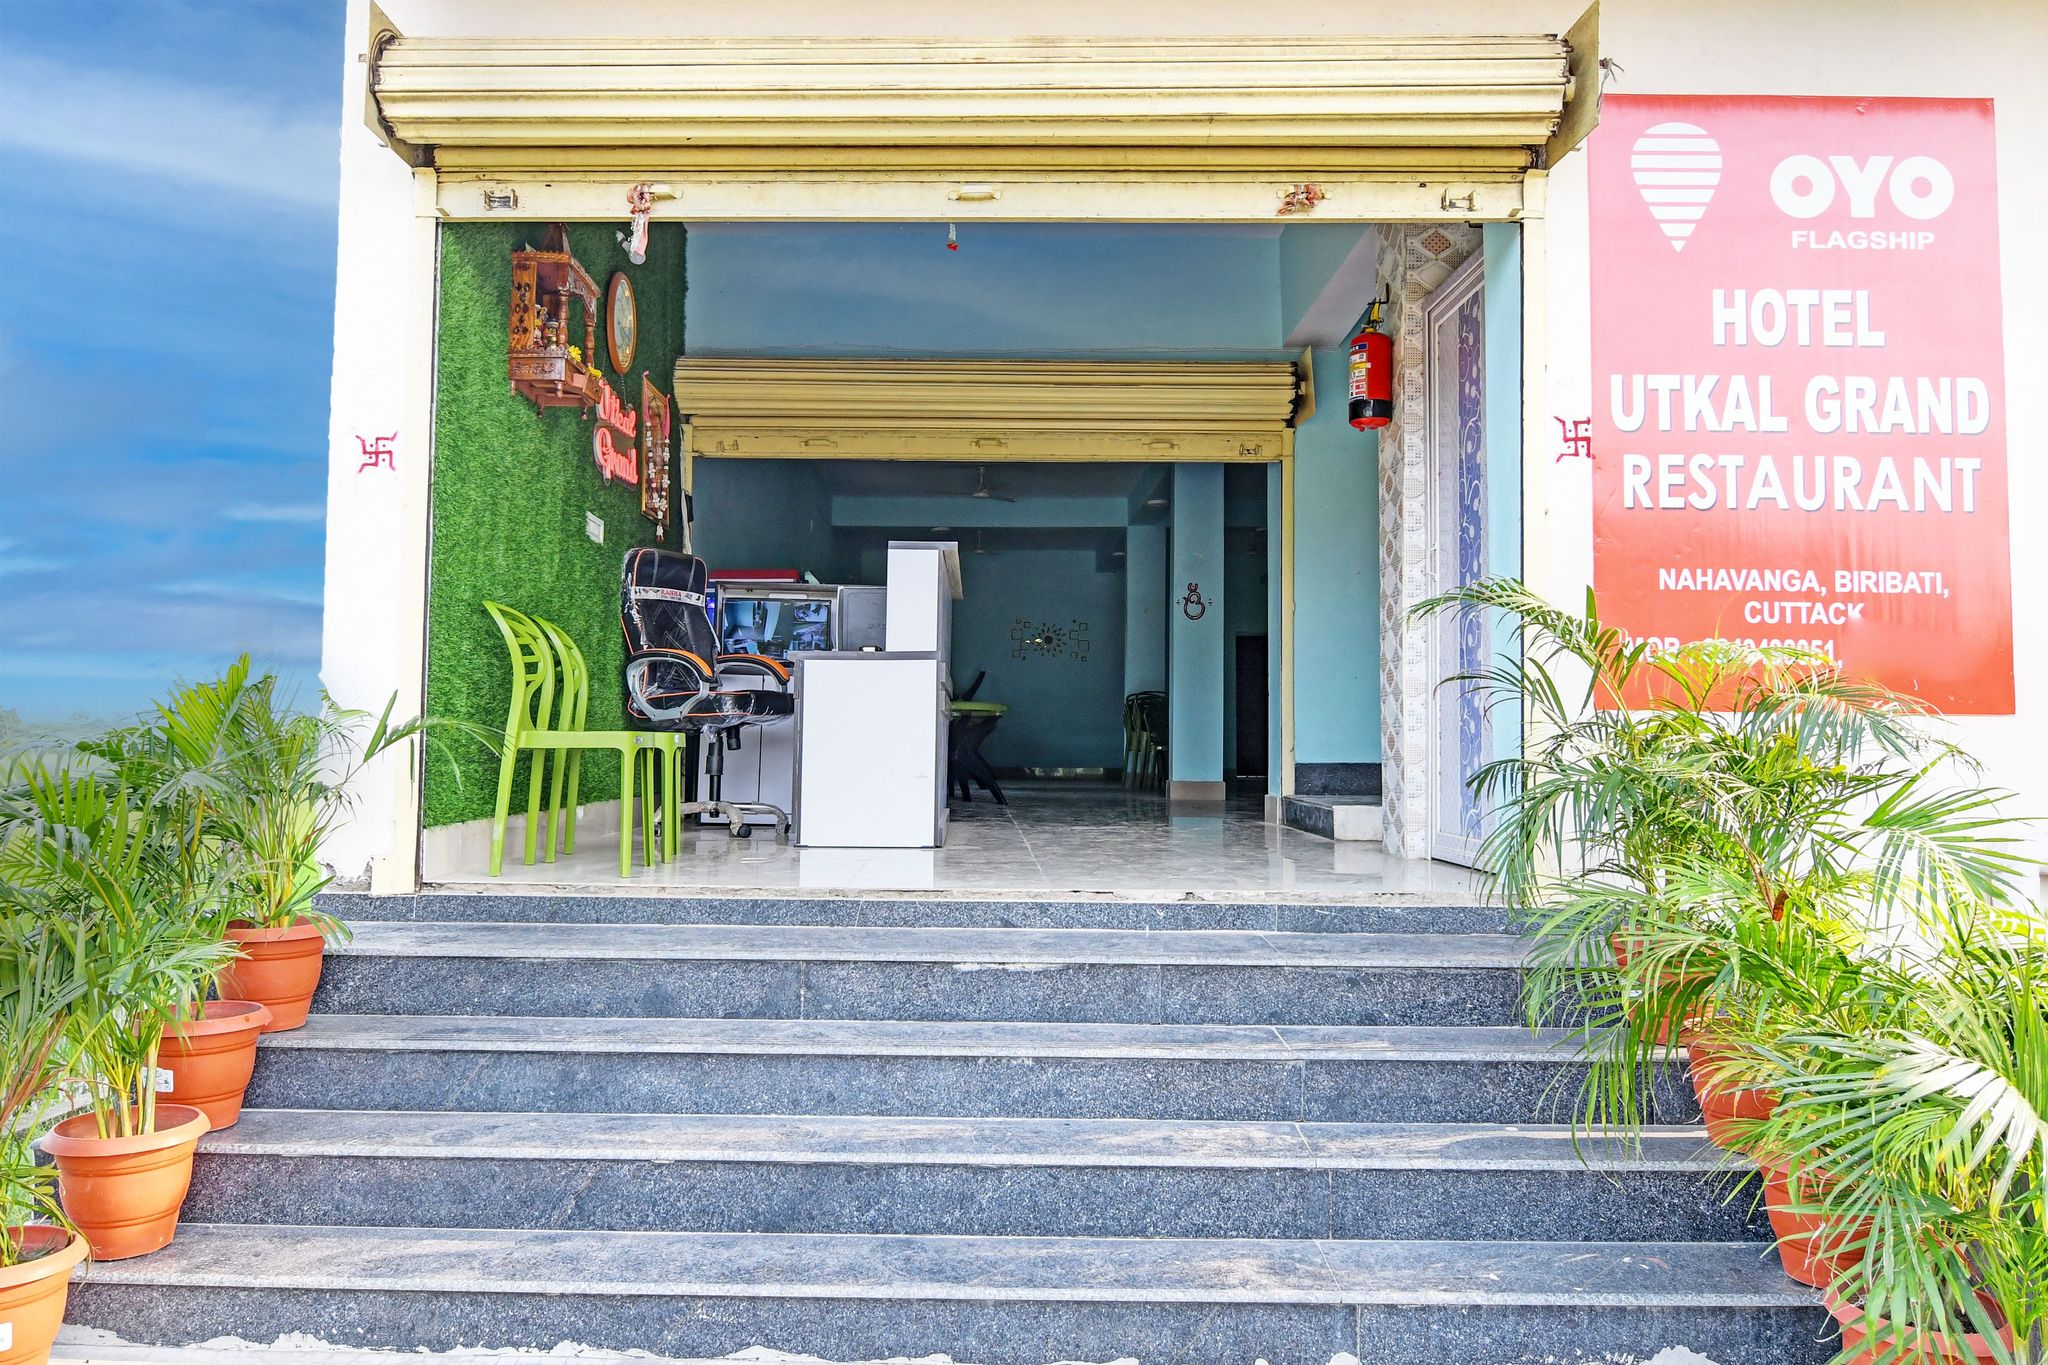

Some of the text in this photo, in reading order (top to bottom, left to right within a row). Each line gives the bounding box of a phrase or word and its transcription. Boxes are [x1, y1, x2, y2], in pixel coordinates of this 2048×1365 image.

[1770, 155, 1954, 220] OYO
[1791, 230, 1935, 251] FLAGSHIP
[1712, 288, 1886, 347] HOTEL
[1610, 374, 1990, 435] UTKAL GRAND
[1622, 453, 1981, 512] RESTAURANT
[1659, 568, 1949, 599] NAHAVANGA, BIRIBATI,
[1744, 601, 1865, 625] CUTTACK
